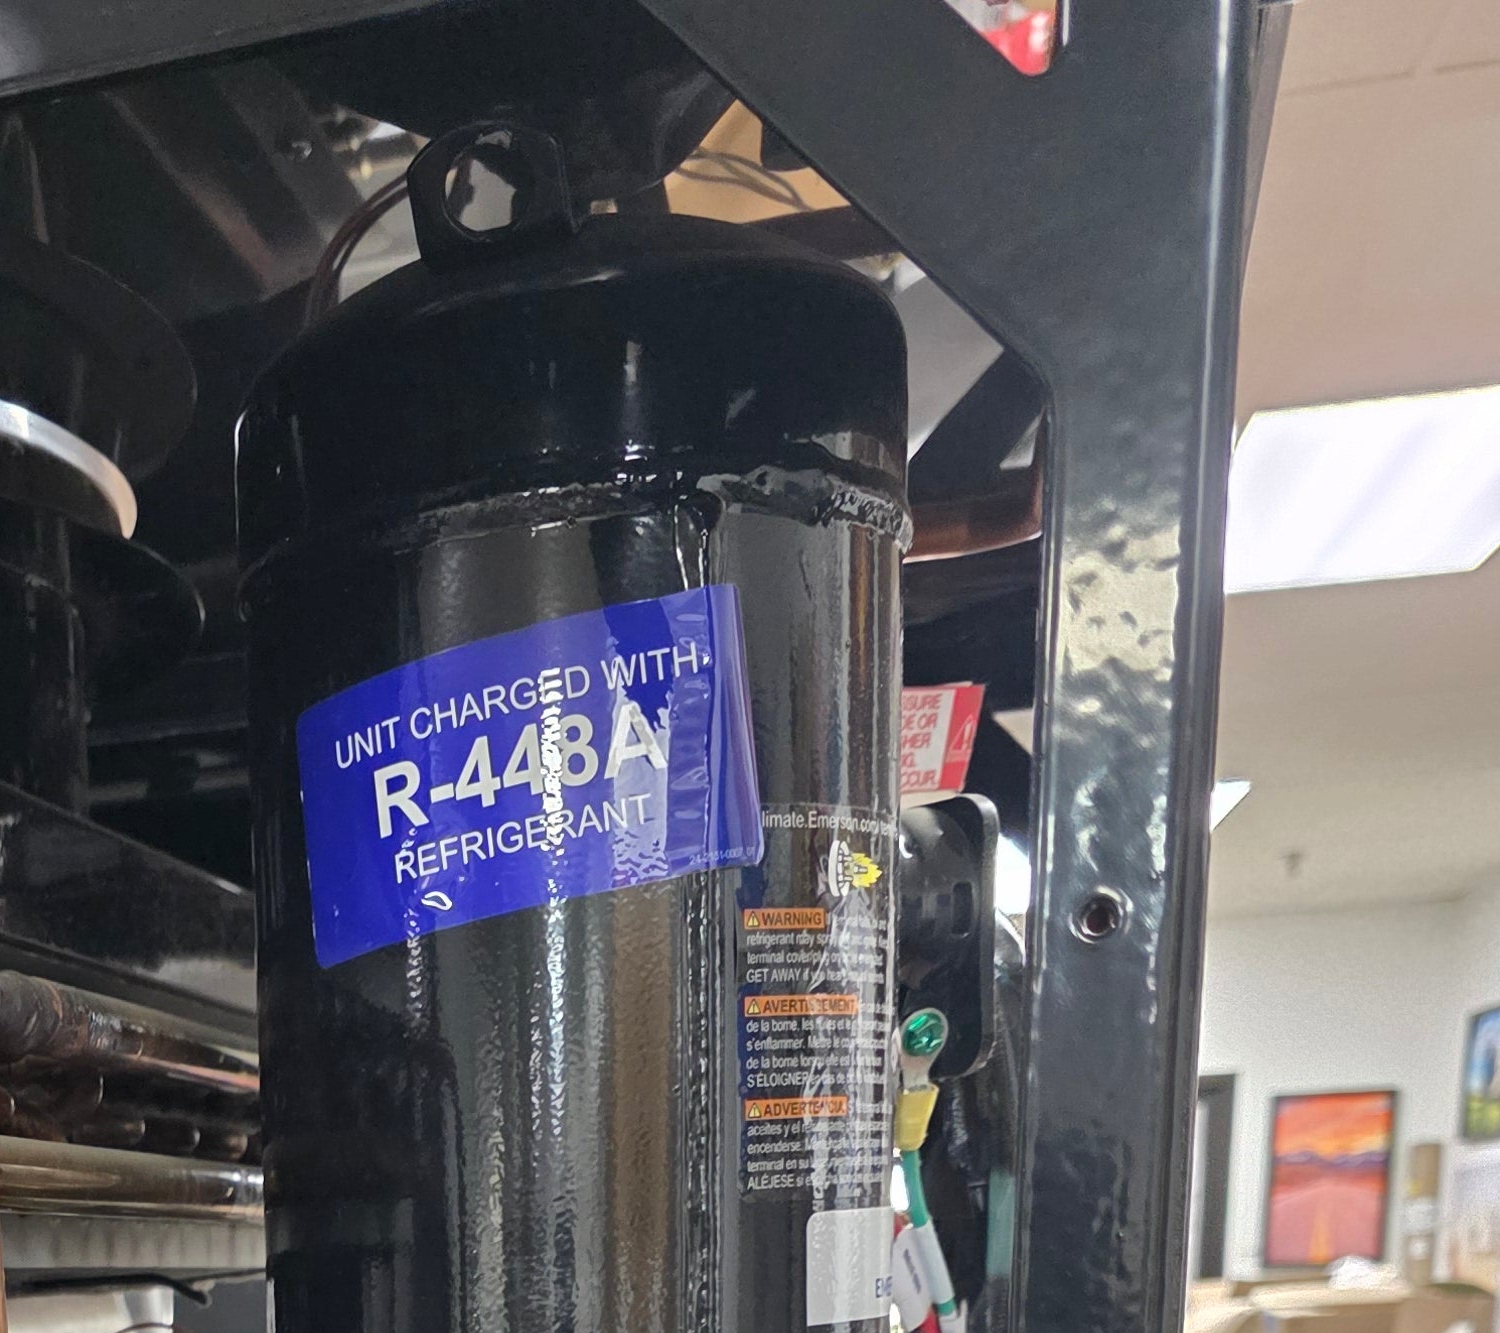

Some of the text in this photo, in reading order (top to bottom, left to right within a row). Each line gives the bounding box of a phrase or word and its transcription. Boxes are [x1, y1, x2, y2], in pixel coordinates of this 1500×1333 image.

[334, 642, 700, 770] UNIT CHARGED WITH
[372, 702, 668, 839] R-448A
[394, 793, 652, 884] REFRIGERANT
[762, 912, 822, 927] WARNING
[746, 968, 802, 984] GET AWAY
